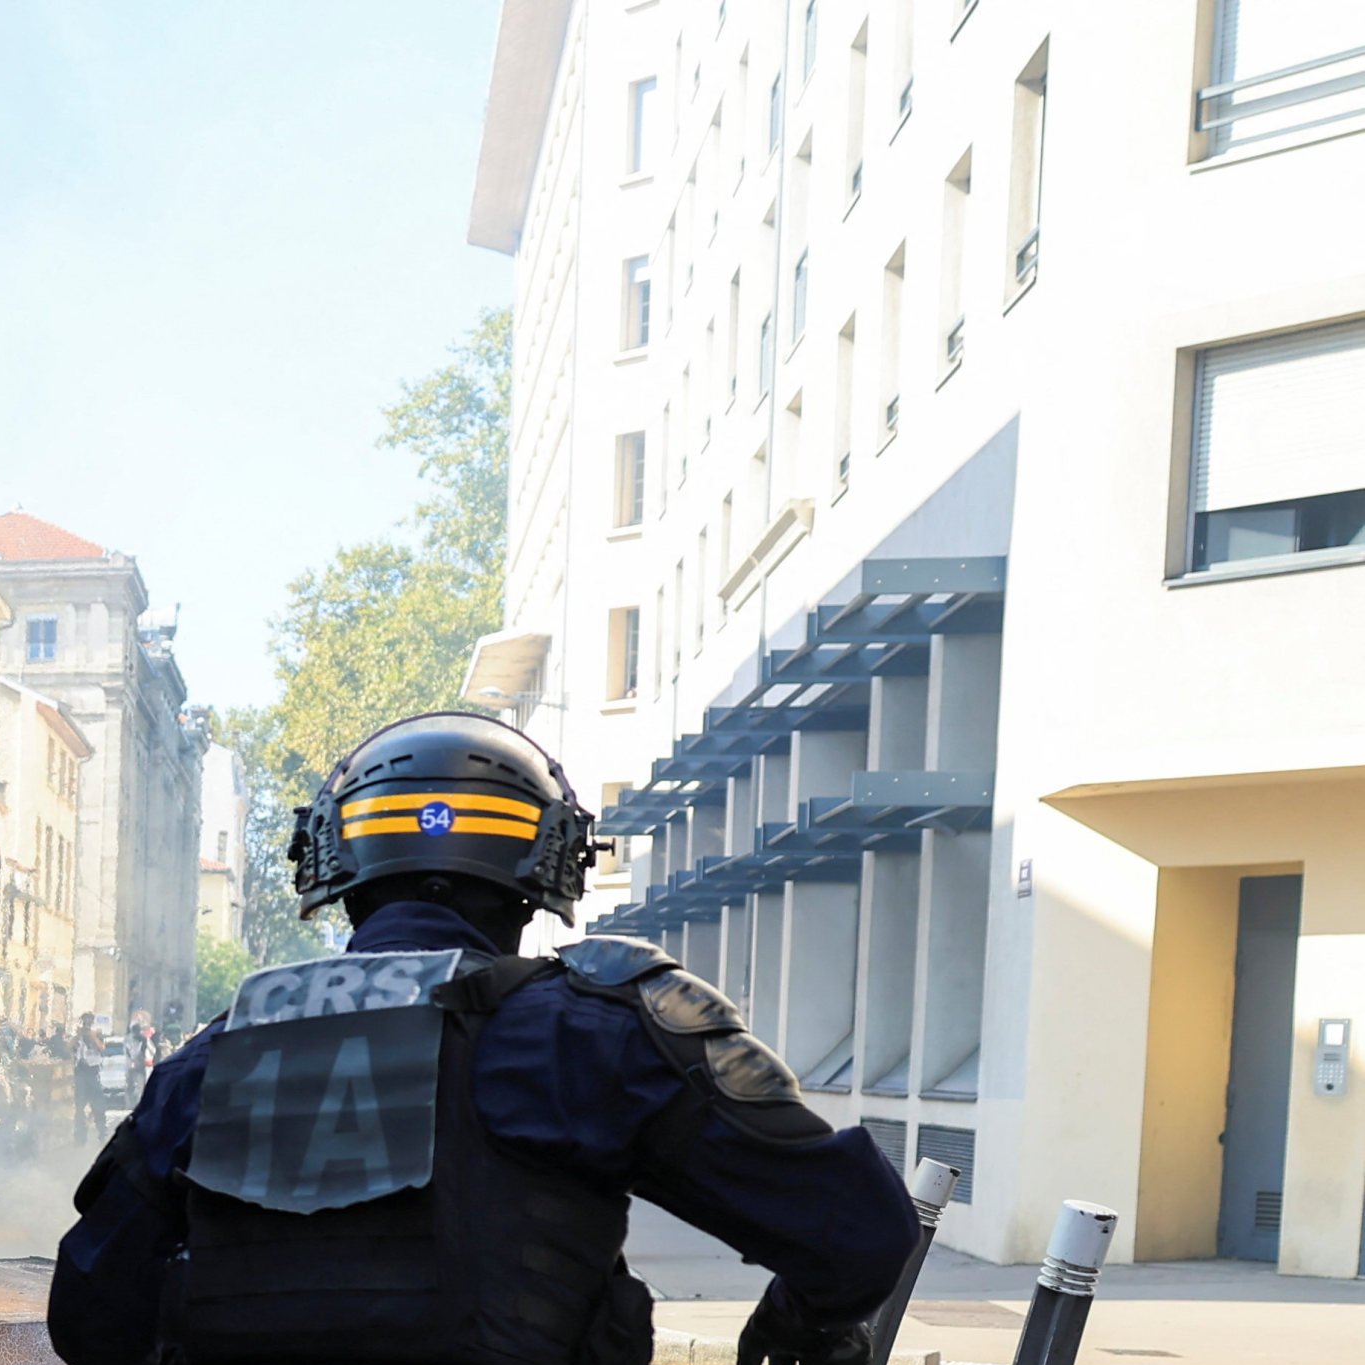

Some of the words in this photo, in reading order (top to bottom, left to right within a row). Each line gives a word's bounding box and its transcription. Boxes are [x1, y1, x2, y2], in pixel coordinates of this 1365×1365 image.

[420, 808, 452, 829] 54
[248, 958, 424, 1026] CRS
[229, 1036, 394, 1199] 1A
